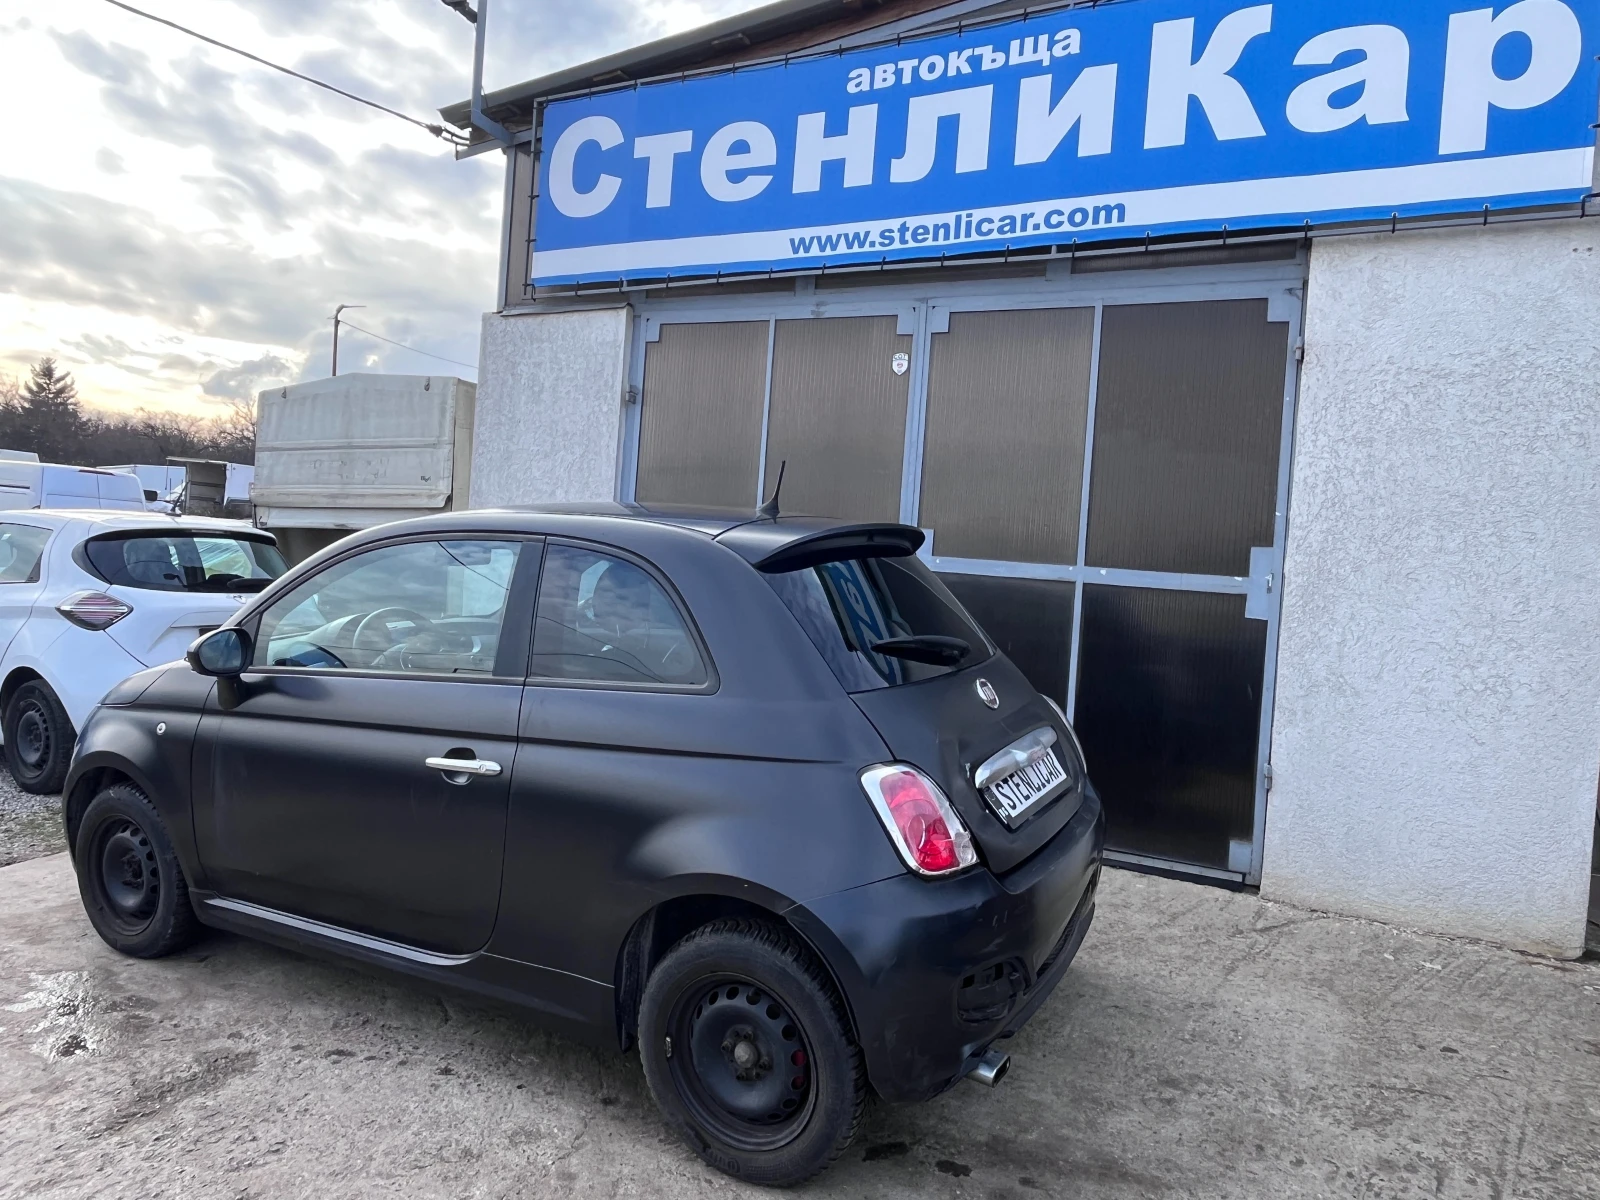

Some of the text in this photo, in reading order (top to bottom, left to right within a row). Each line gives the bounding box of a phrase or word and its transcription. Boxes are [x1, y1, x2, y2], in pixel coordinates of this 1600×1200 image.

[846, 28, 1081, 94] автокъща
[548, 0, 1582, 218] СтенлиКар
[789, 203, 1126, 255] www.stenlicar.com
[995, 754, 1062, 811] STENLICAR
